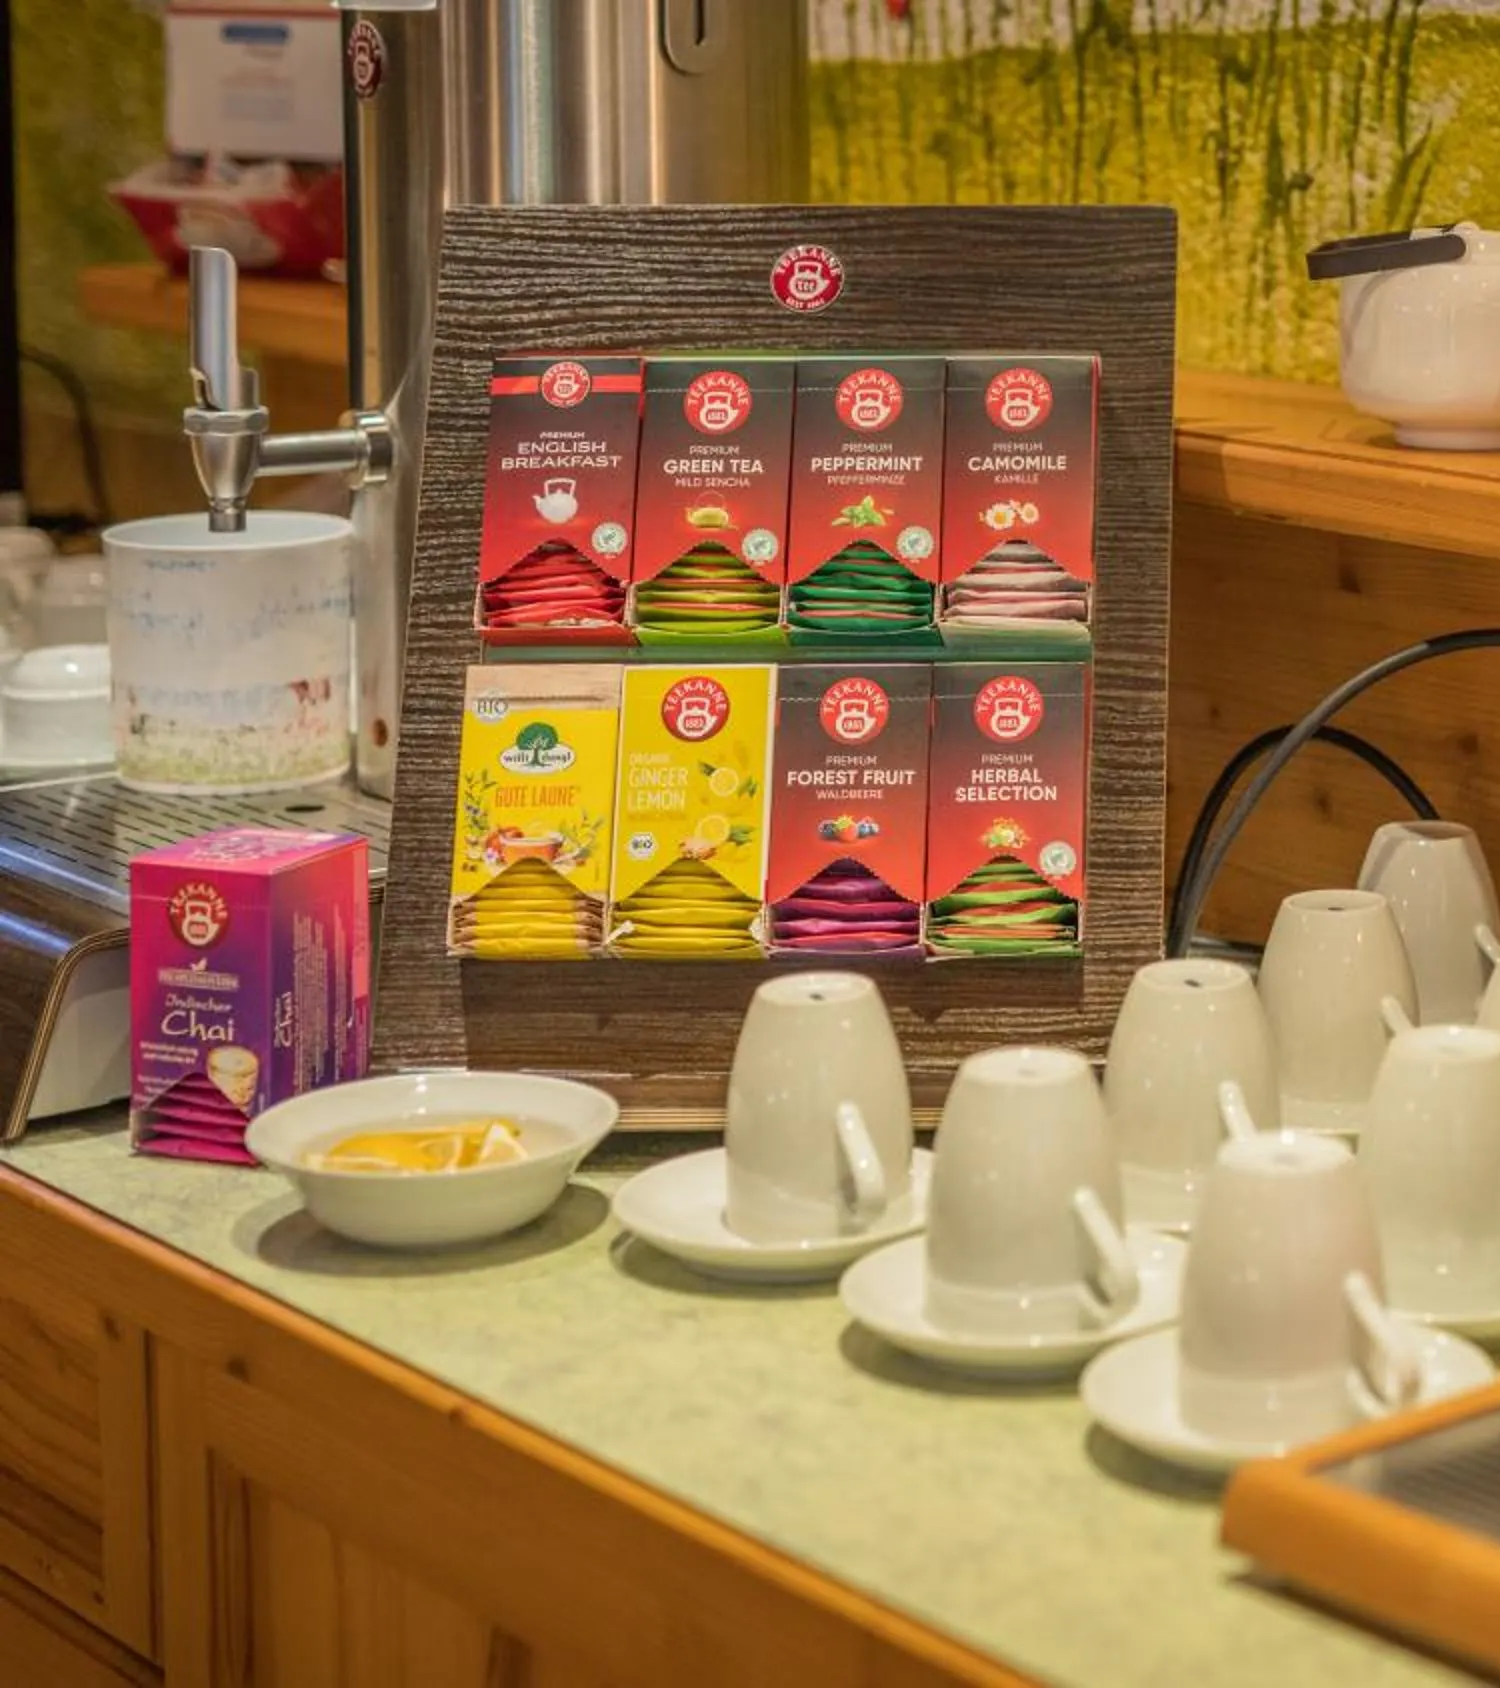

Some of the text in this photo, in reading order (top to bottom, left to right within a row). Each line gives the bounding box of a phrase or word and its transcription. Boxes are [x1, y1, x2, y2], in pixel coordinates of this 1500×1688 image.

[687, 376, 749, 405] TEEKANNE
[839, 373, 900, 402] TEEKANNE
[991, 373, 1049, 402] TEEKANNE
[518, 441, 607, 454] ENGLISH
[690, 445, 740, 455] PREMIUM
[843, 443, 893, 453] PREMIUM
[992, 442, 1043, 452] PREMIUM
[501, 456, 623, 470] BREAKFAST
[663, 459, 763, 473] GREEN TEA
[811, 457, 923, 472] PEPPERMINT
[968, 455, 1067, 471] CAMOMILE
[675, 477, 751, 488] MILD SENCHA
[994, 474, 1040, 484] KAMILLE
[664, 679, 727, 713] TEEKANNE
[824, 681, 884, 713] TEEKANNE
[977, 680, 1041, 713] TEEKANNE
[826, 755, 877, 766] PREMIUM
[981, 754, 1034, 764] PREMIUM
[629, 767, 688, 787] GINGER
[787, 770, 916, 786] FOREST FRUIT
[971, 769, 1043, 784] HERBAL
[495, 785, 576, 808] GUTE LAUNE
[627, 789, 686, 812] LEMON
[816, 788, 884, 800] WALDBEERE
[955, 785, 1057, 802] SELECTION
[170, 883, 228, 919] TEEKANNE
[160, 1009, 235, 1042] Chai
